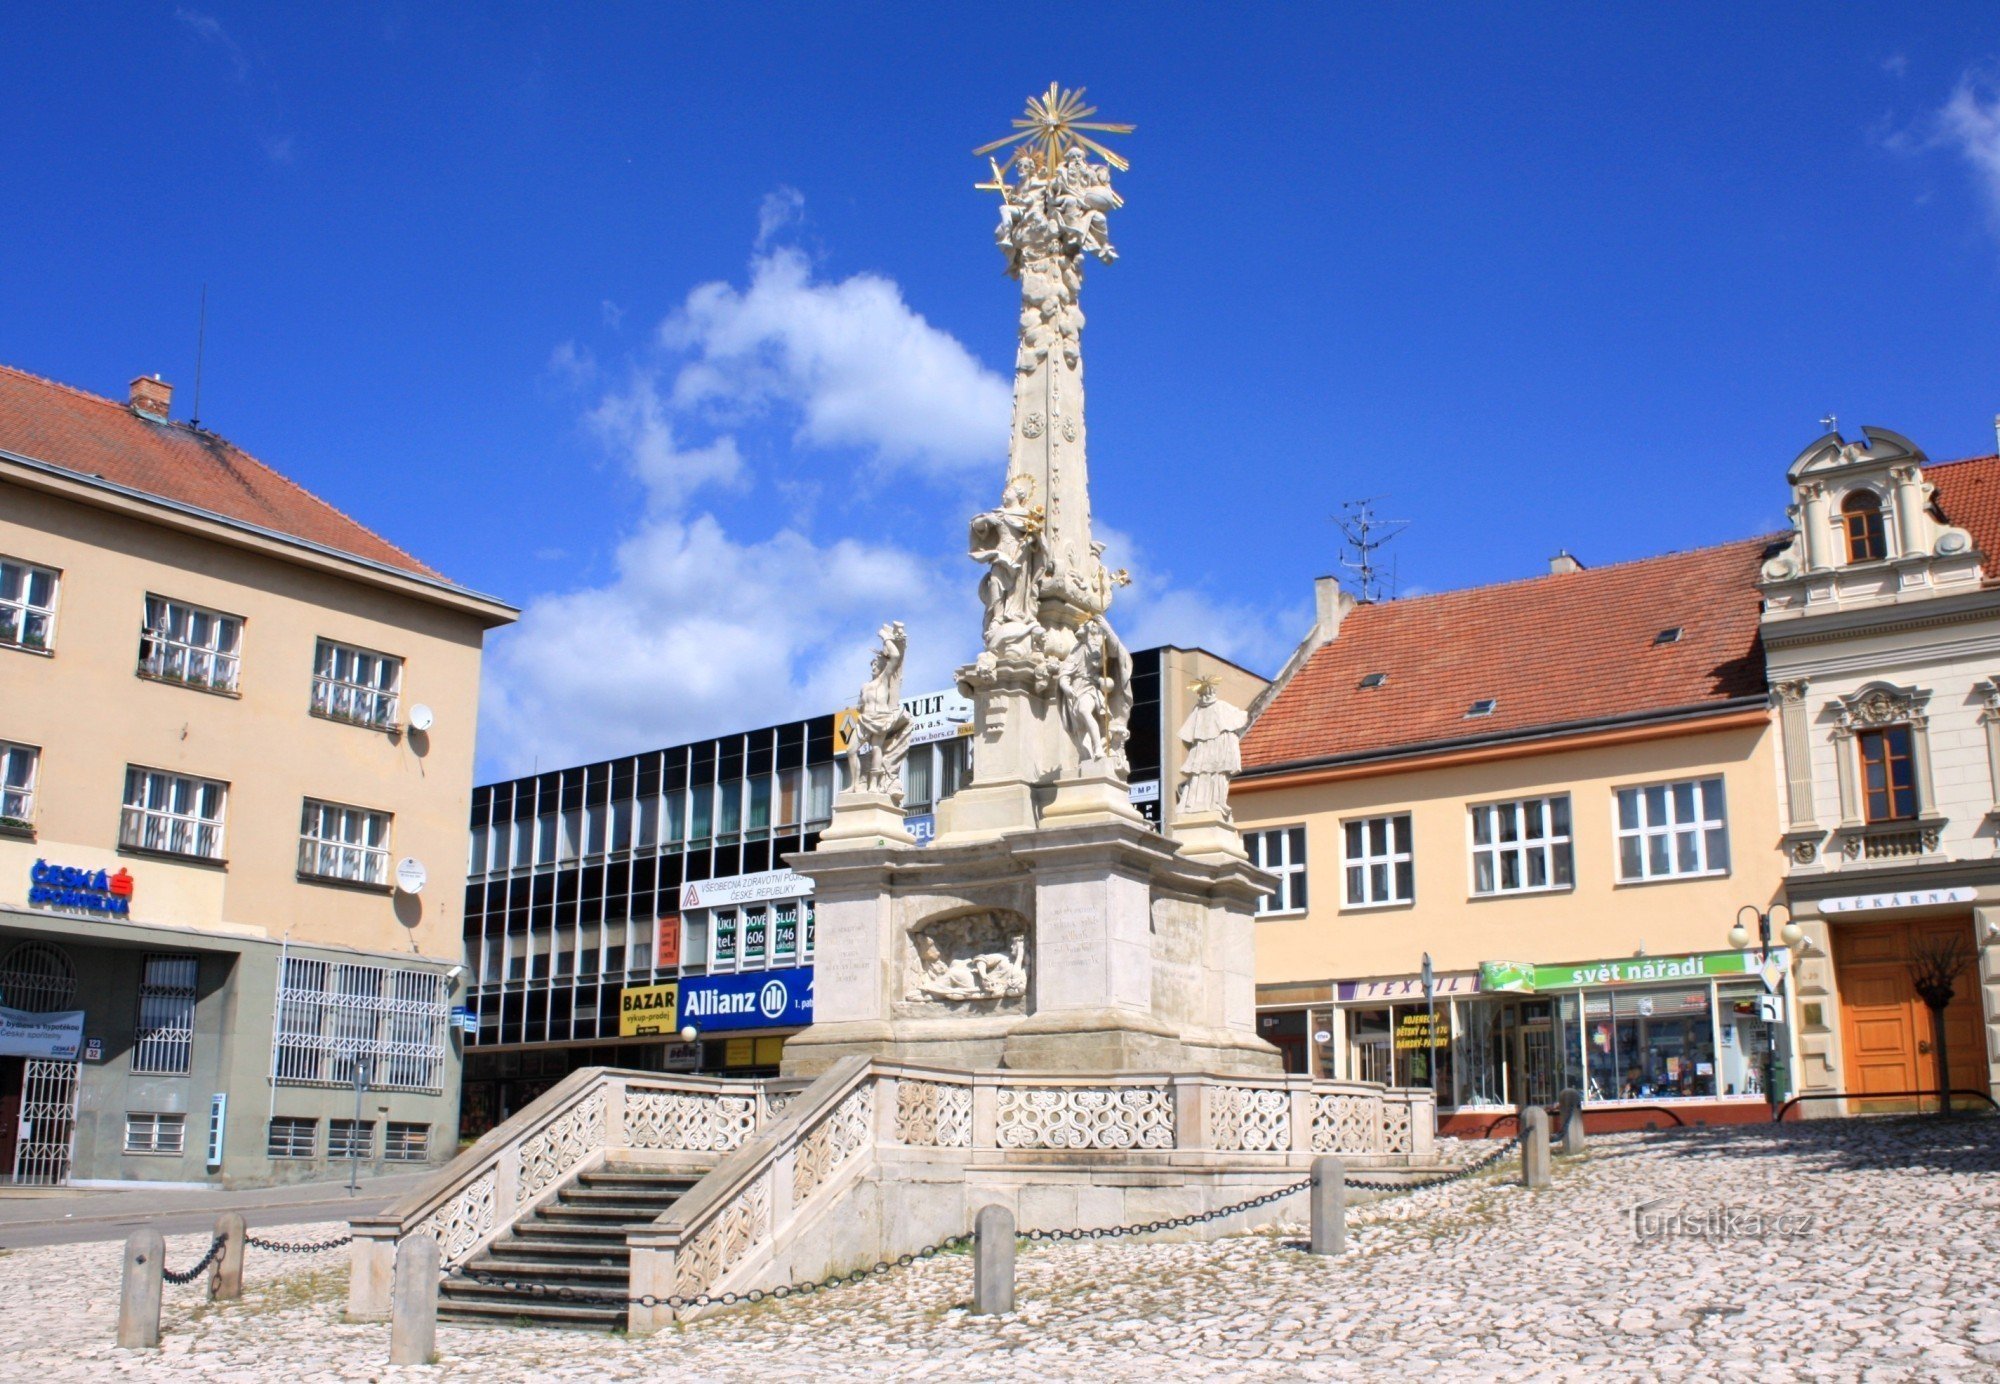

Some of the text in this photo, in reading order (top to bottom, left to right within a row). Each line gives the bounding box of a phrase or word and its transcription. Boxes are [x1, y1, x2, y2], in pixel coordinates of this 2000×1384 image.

[31, 858, 108, 891] ČESKÁ
[756, 884, 796, 899] REPUBLIKY
[1838, 892, 1957, 911] LÉKÁRNA
[747, 931, 764, 944] 606
[777, 928, 794, 941] 746
[1573, 957, 1704, 984] svět nářadí
[1367, 978, 1458, 997] TEXIL
[623, 991, 675, 1011] BAZAR
[684, 989, 756, 1016] Allianz
[90, 1049, 98, 1058] 32
